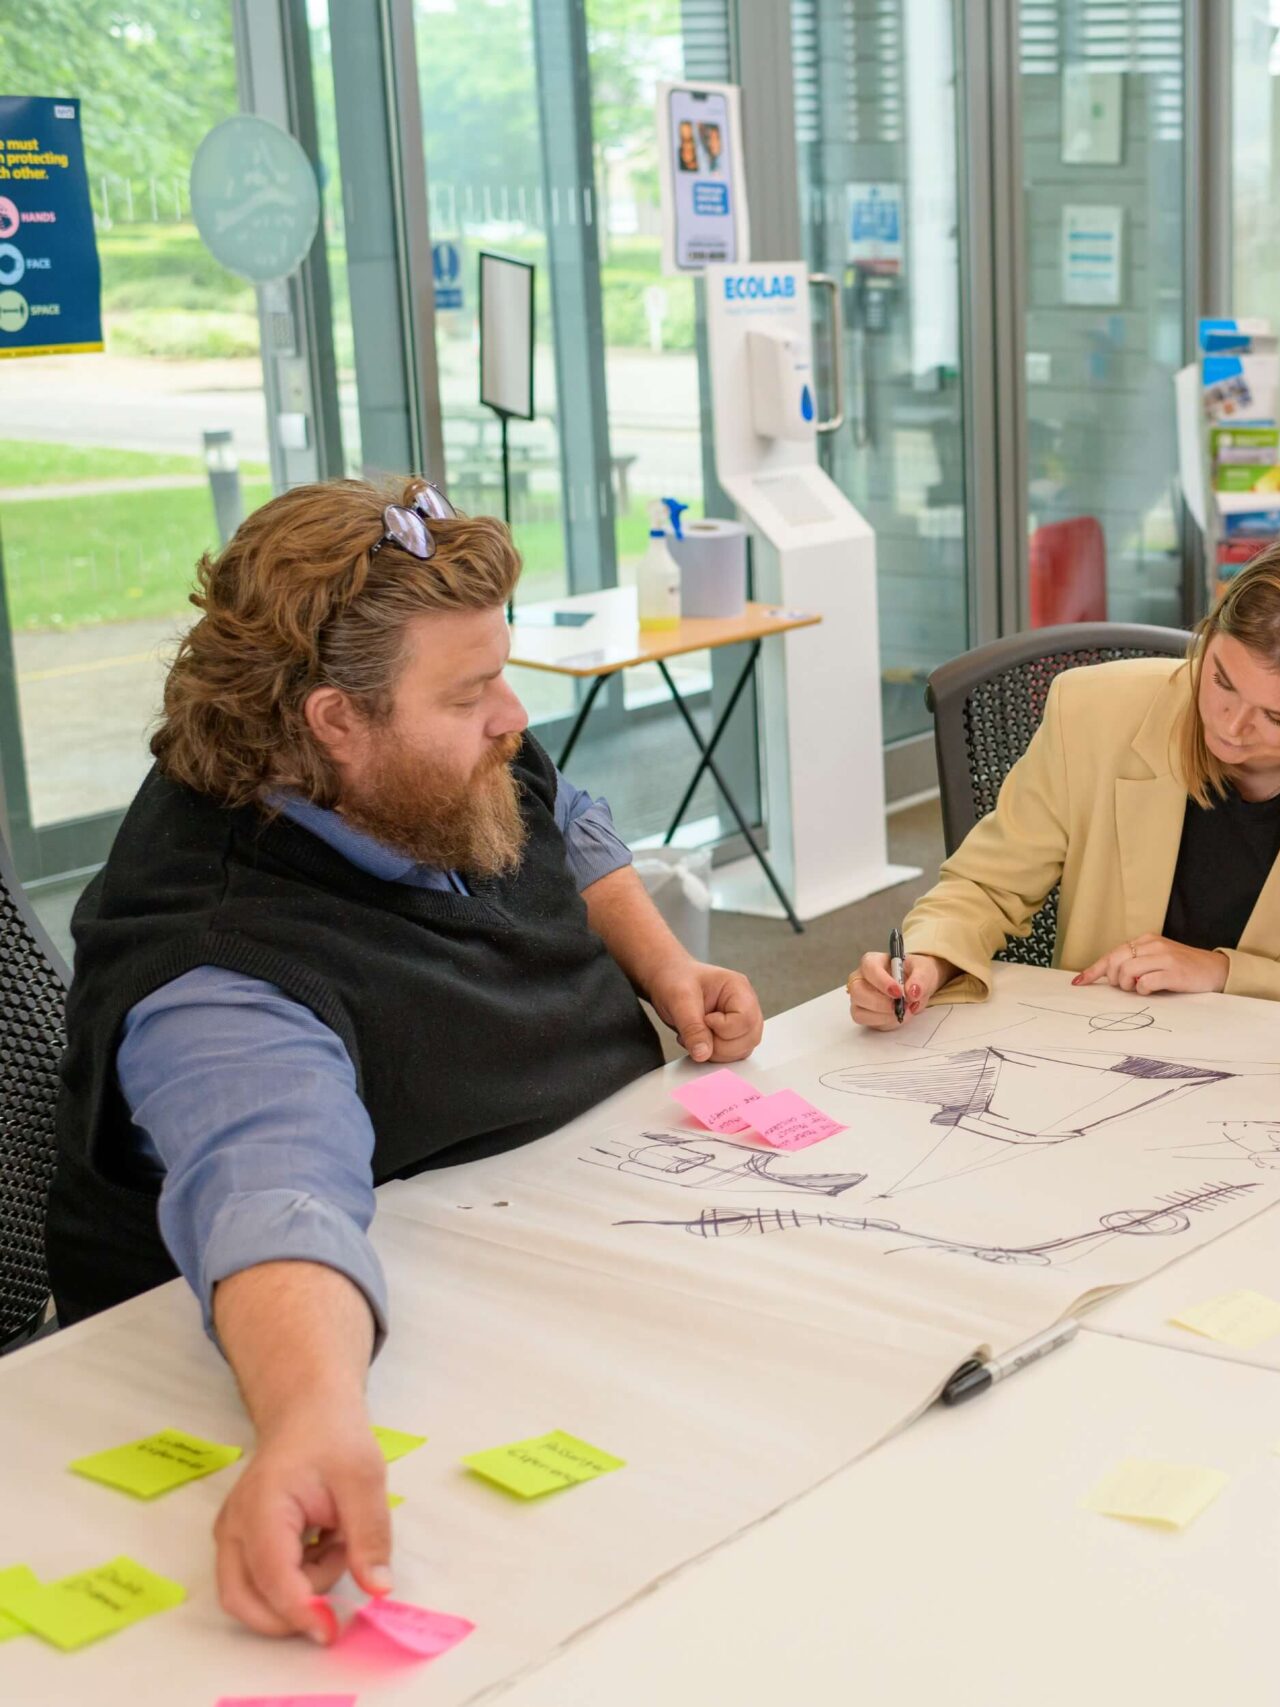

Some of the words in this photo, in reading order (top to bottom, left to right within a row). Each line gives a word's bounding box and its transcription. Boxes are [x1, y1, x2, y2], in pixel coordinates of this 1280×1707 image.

[6, 138, 39, 151] must
[6, 151, 69, 169] protecting
[12, 166, 49, 179] other.
[20, 211, 56, 223] HANDS
[26, 258, 51, 270] FACE
[724, 275, 796, 300] ECOLAB
[30, 303, 60, 316] SPACE
